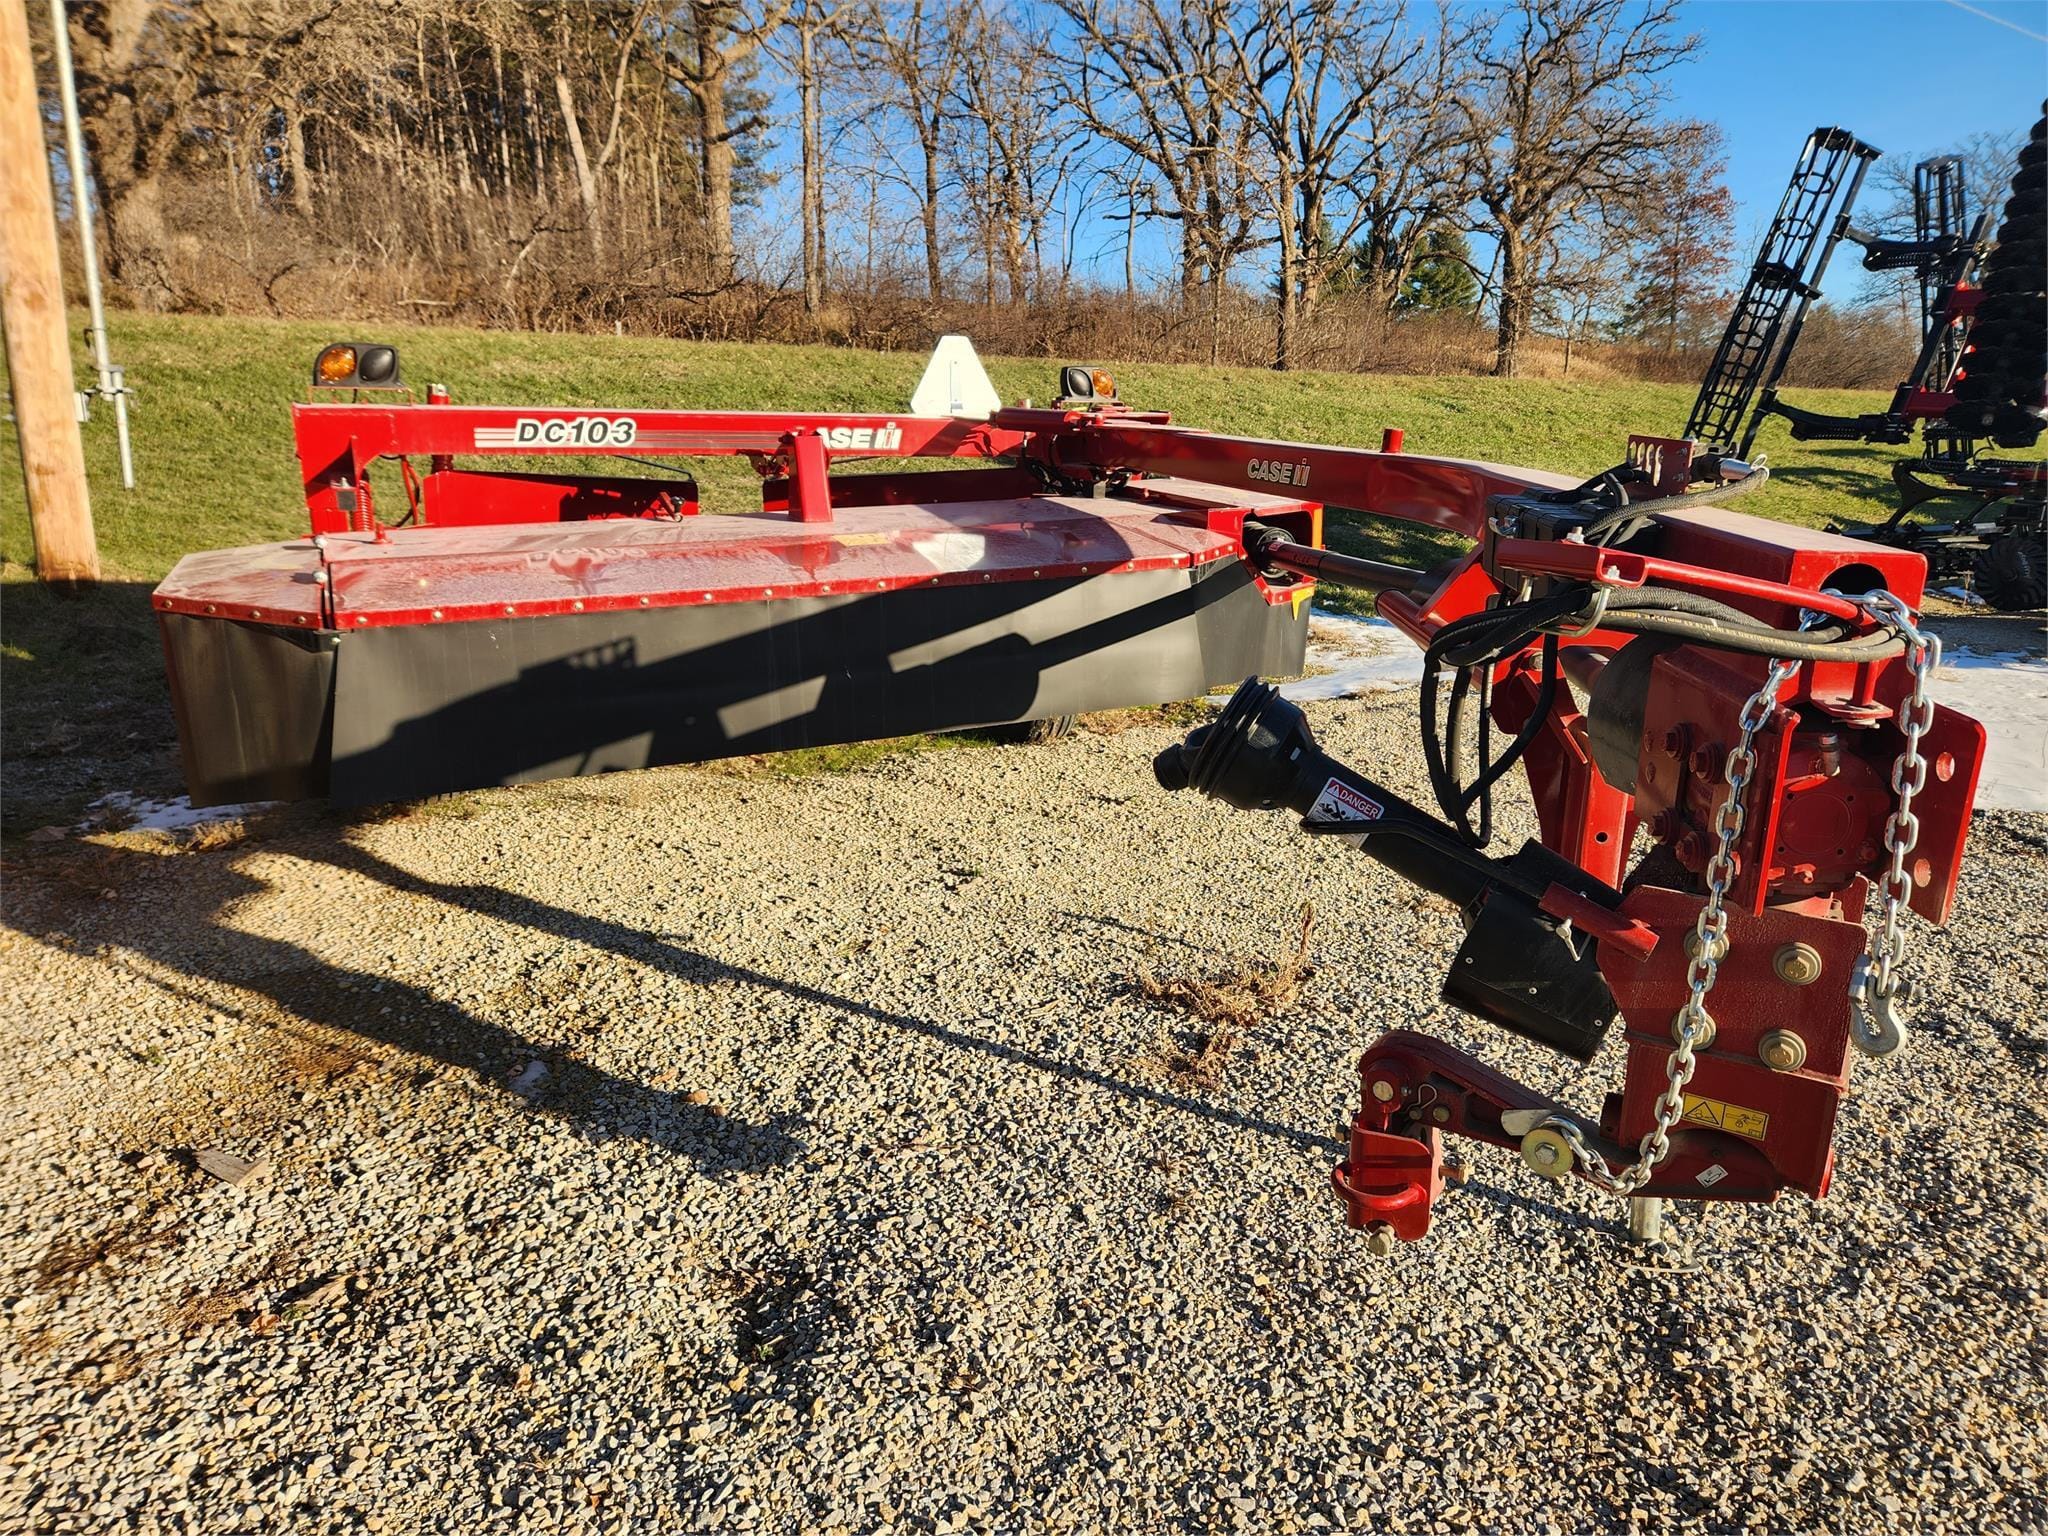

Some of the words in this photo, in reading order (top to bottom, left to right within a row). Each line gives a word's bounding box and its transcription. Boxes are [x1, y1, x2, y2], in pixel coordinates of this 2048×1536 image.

[516, 418, 635, 445] DC103
[1247, 458, 1294, 485] CASE
[1339, 790, 1379, 819] DANGER
